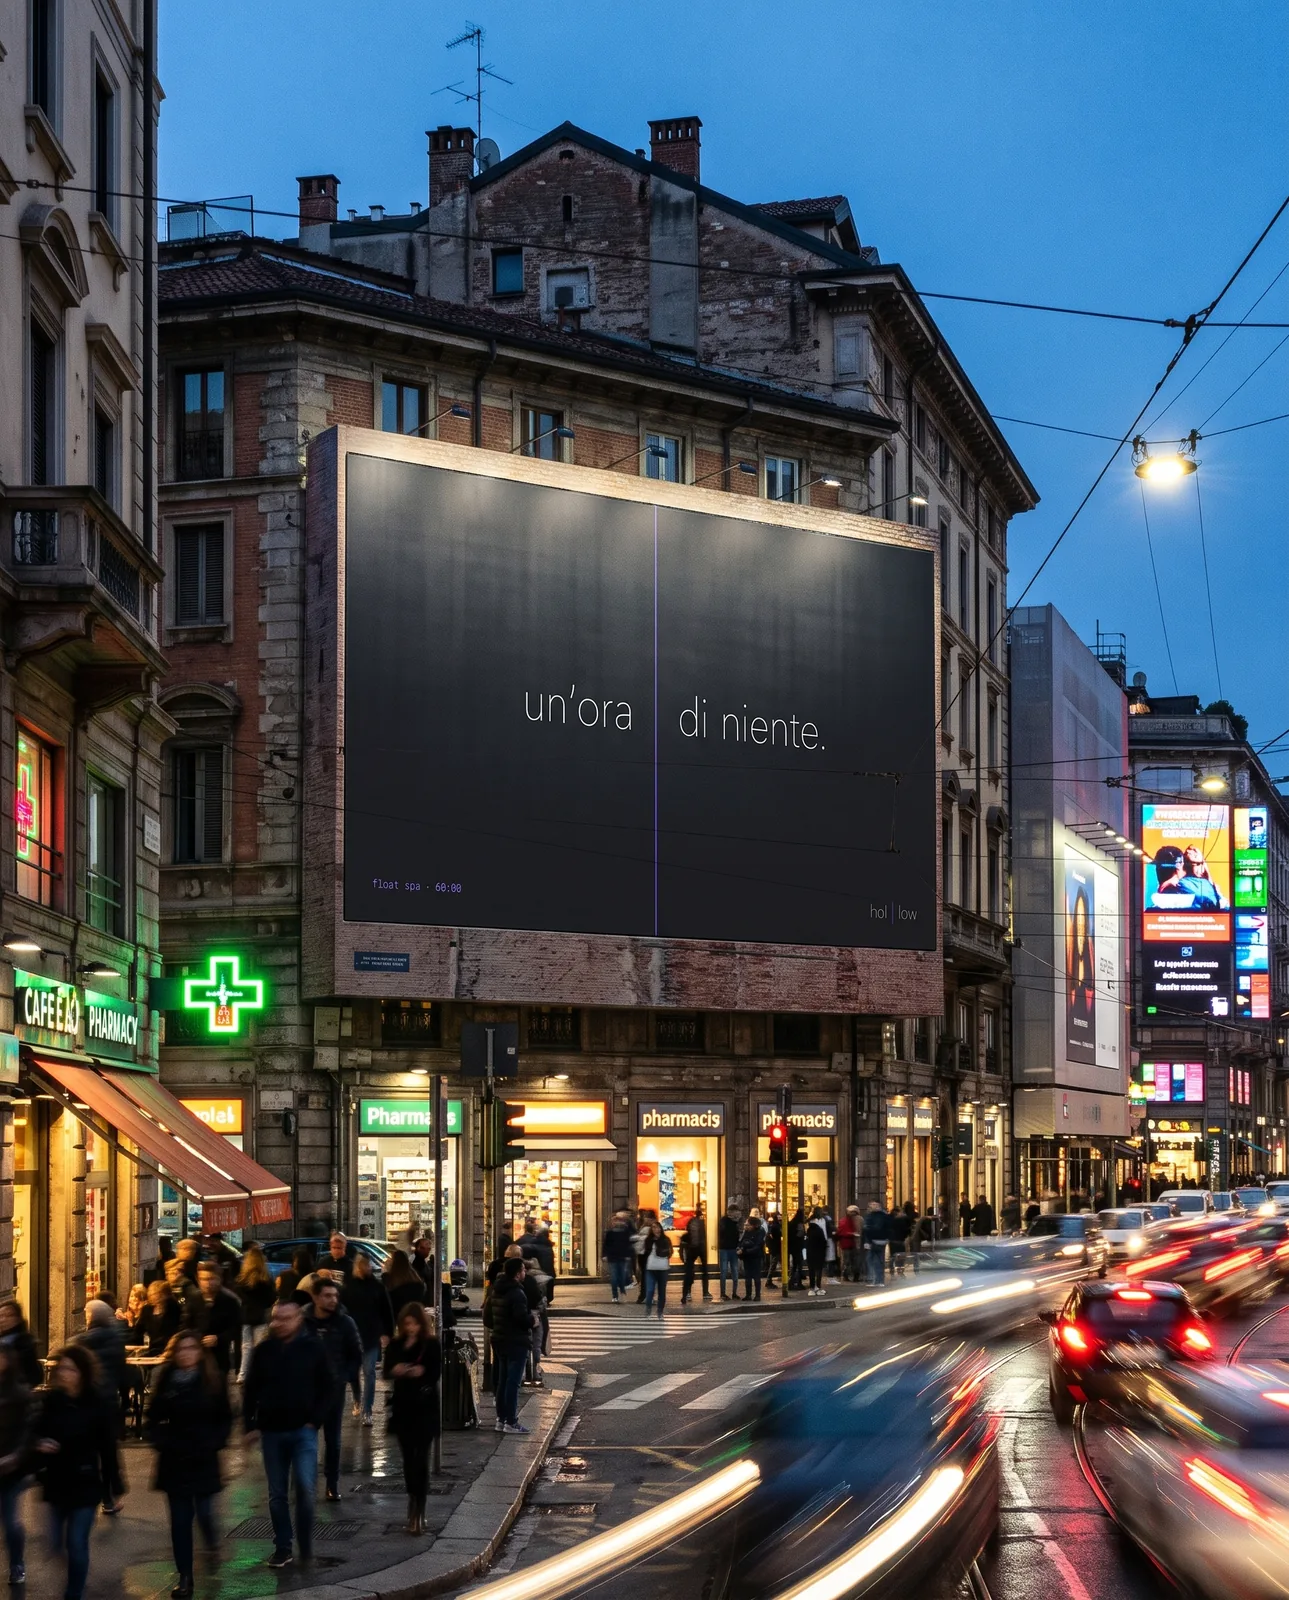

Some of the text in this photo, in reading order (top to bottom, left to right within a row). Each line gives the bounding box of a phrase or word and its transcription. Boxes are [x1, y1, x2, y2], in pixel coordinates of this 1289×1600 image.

[525, 684, 826, 751] un'ora di niente.
[372, 878, 399, 890] float
[404, 882, 421, 892] spa
[435, 882, 462, 893] 60:00
[89, 1005, 138, 1046] PHARMACY
[367, 1106, 457, 1126] Pharmas
[642, 1108, 721, 1130] pharmacis
